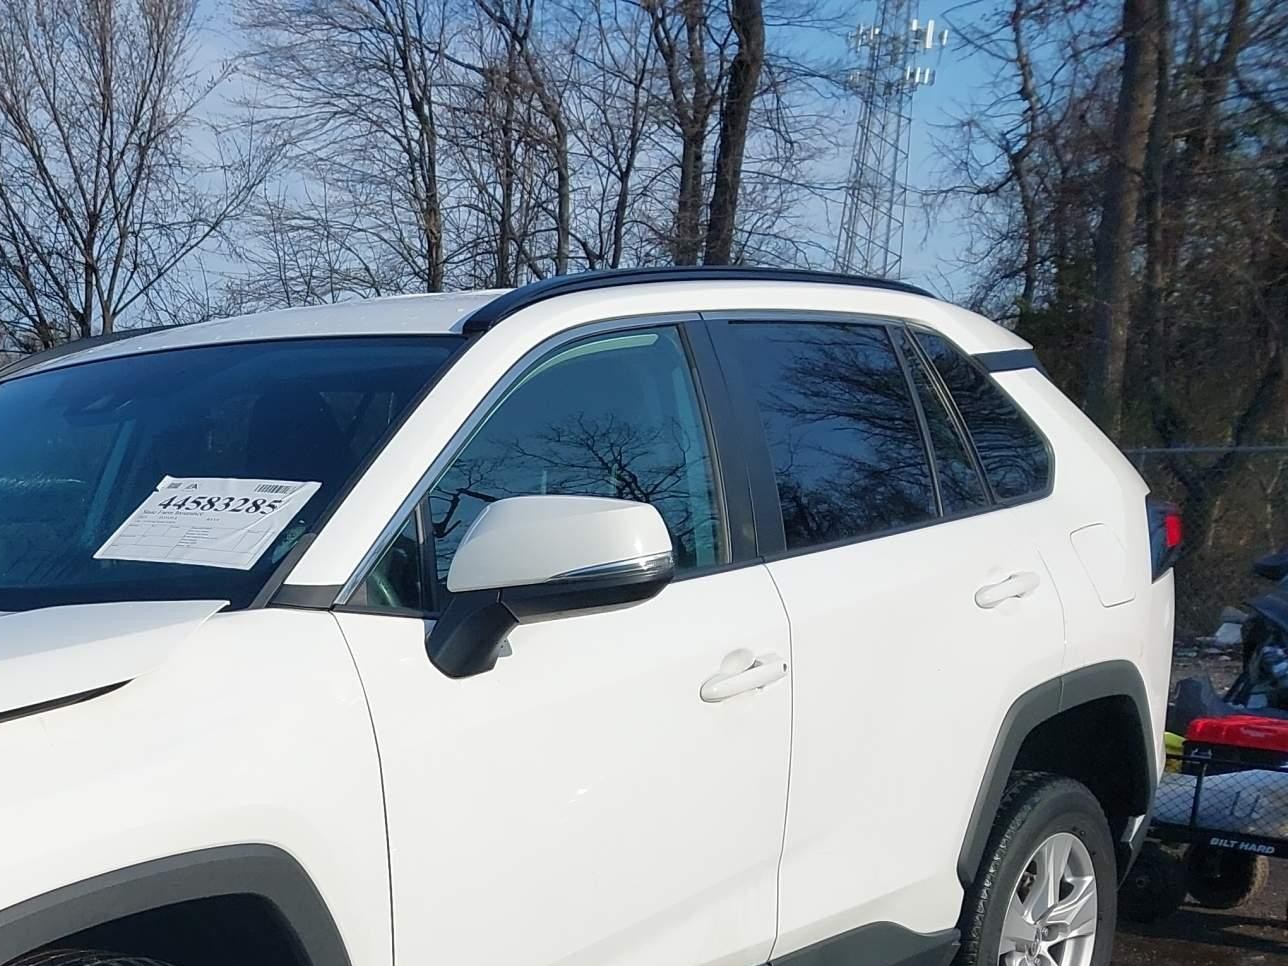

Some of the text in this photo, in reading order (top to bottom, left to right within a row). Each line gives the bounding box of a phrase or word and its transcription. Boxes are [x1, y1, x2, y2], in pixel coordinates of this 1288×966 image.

[158, 495, 282, 515] 44583285
[1210, 838, 1275, 854] BILT HARD
